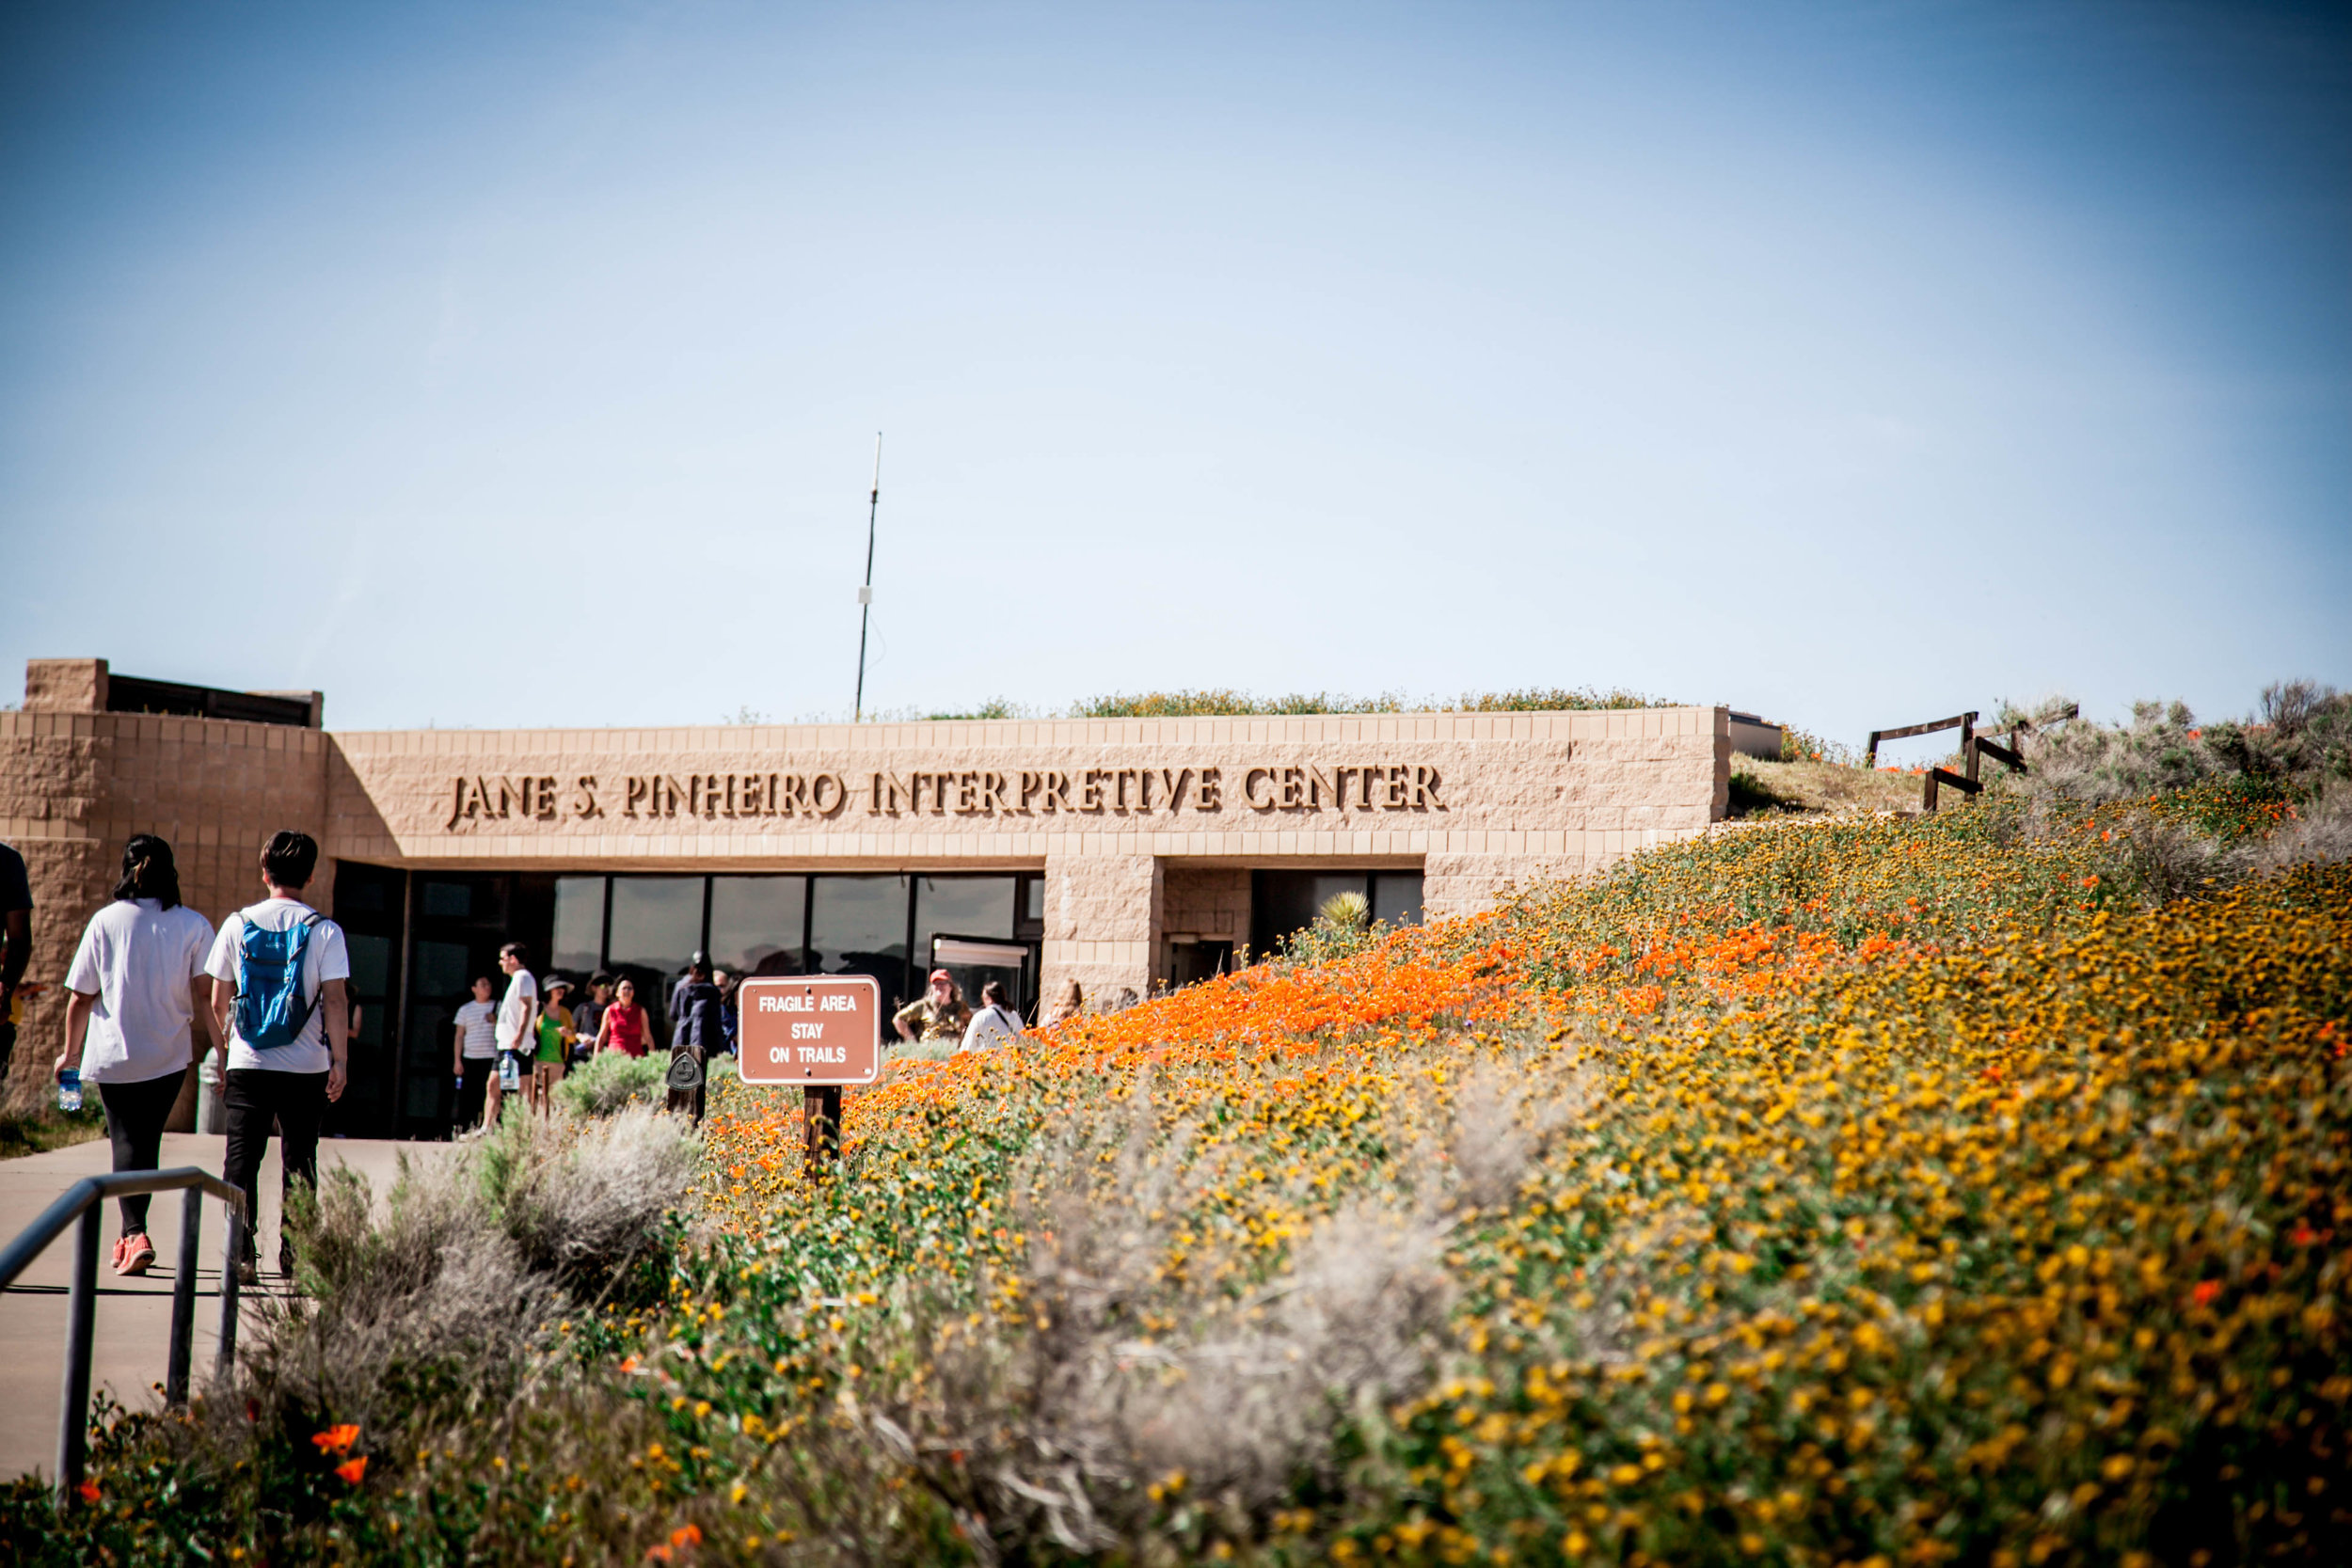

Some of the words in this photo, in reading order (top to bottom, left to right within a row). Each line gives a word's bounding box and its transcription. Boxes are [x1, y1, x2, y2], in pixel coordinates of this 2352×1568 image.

[448, 775, 556, 831] JANE
[574, 775, 603, 818] S.
[623, 773, 846, 818] PINHEIRO
[867, 767, 1221, 816] INTERPRETIVE
[1239, 765, 1447, 812] CENTER
[758, 996, 815, 1012] FRAGILE
[819, 995, 856, 1011] AREA
[791, 1023, 823, 1039] STAY
[770, 1047, 789, 1063] ON
[797, 1047, 846, 1063] TRAILS
